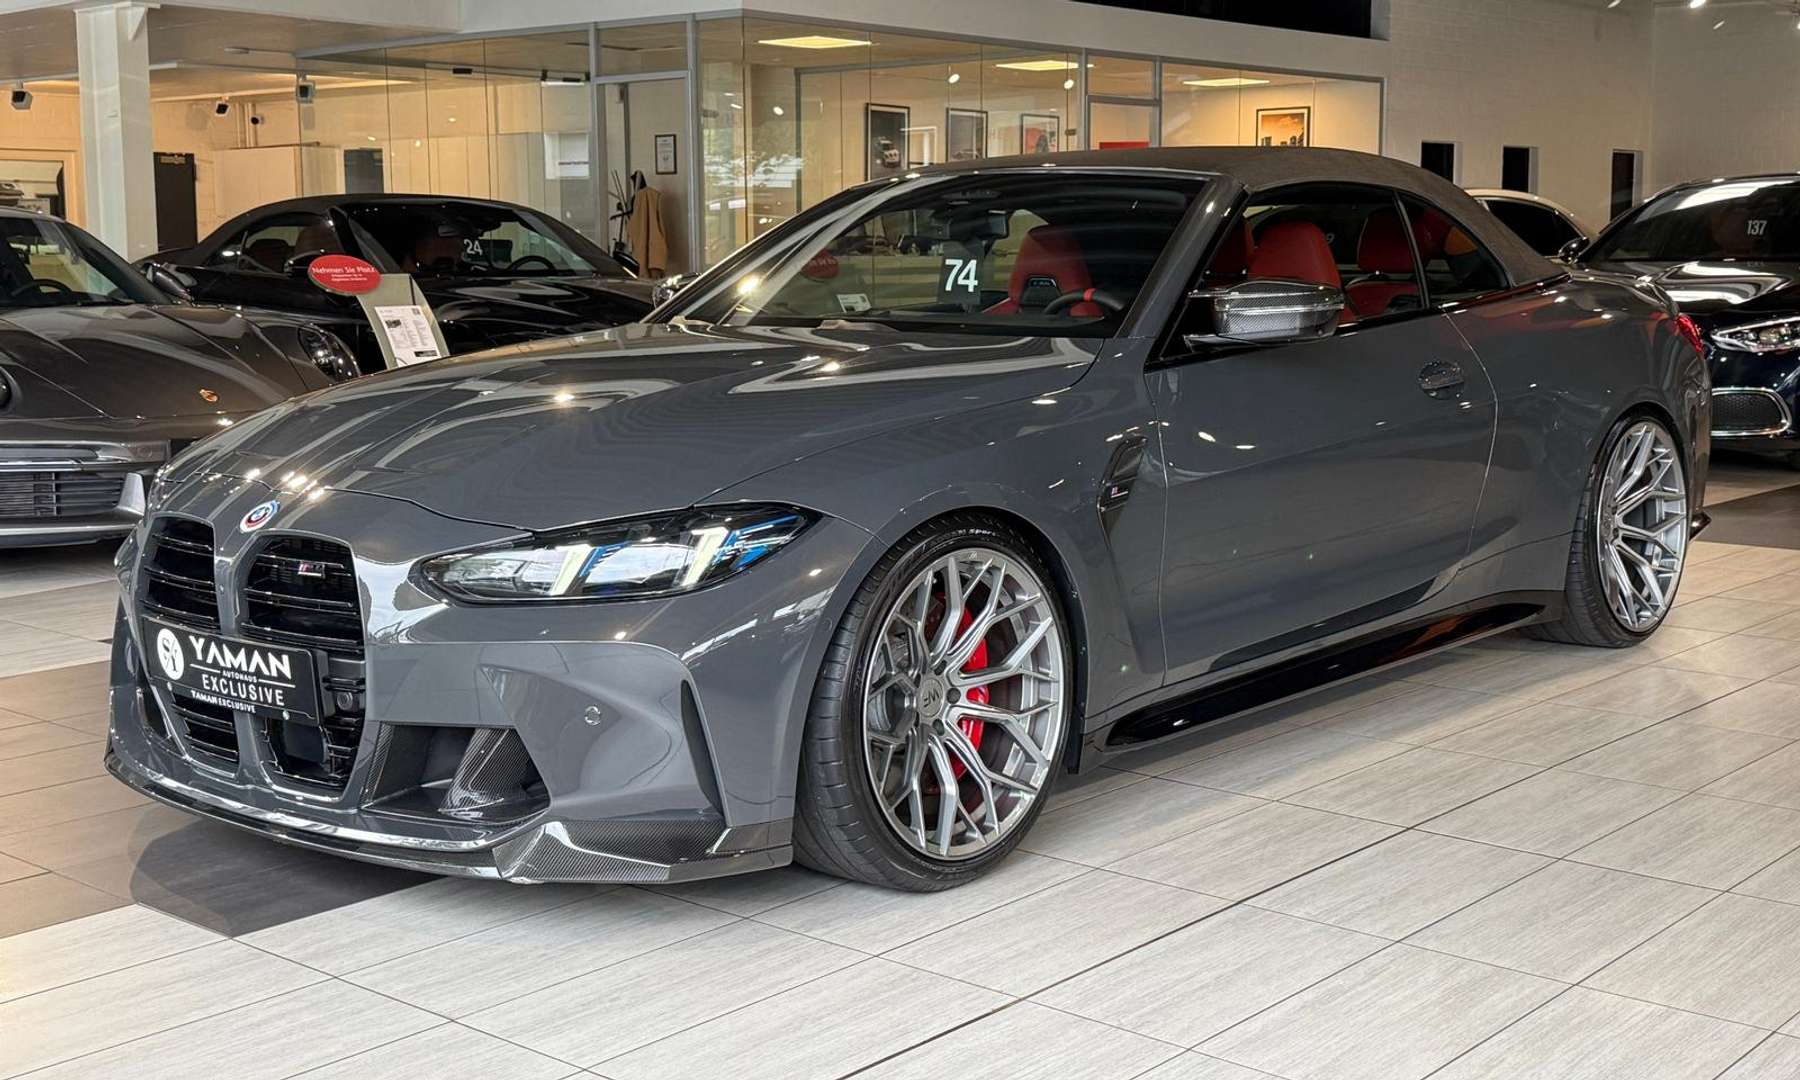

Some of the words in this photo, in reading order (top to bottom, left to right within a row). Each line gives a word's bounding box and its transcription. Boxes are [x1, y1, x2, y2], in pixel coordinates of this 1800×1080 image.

[1747, 220, 1768, 236] 137
[463, 238, 483, 256] 24
[345, 265, 356, 274] Sie
[945, 258, 979, 293] 74
[189, 635, 292, 680] YAMAN
[222, 670, 257, 683] AUTOHAUS
[202, 674, 285, 707] EXCLUSIVE
[218, 697, 256, 713] EXCLUSIVE
